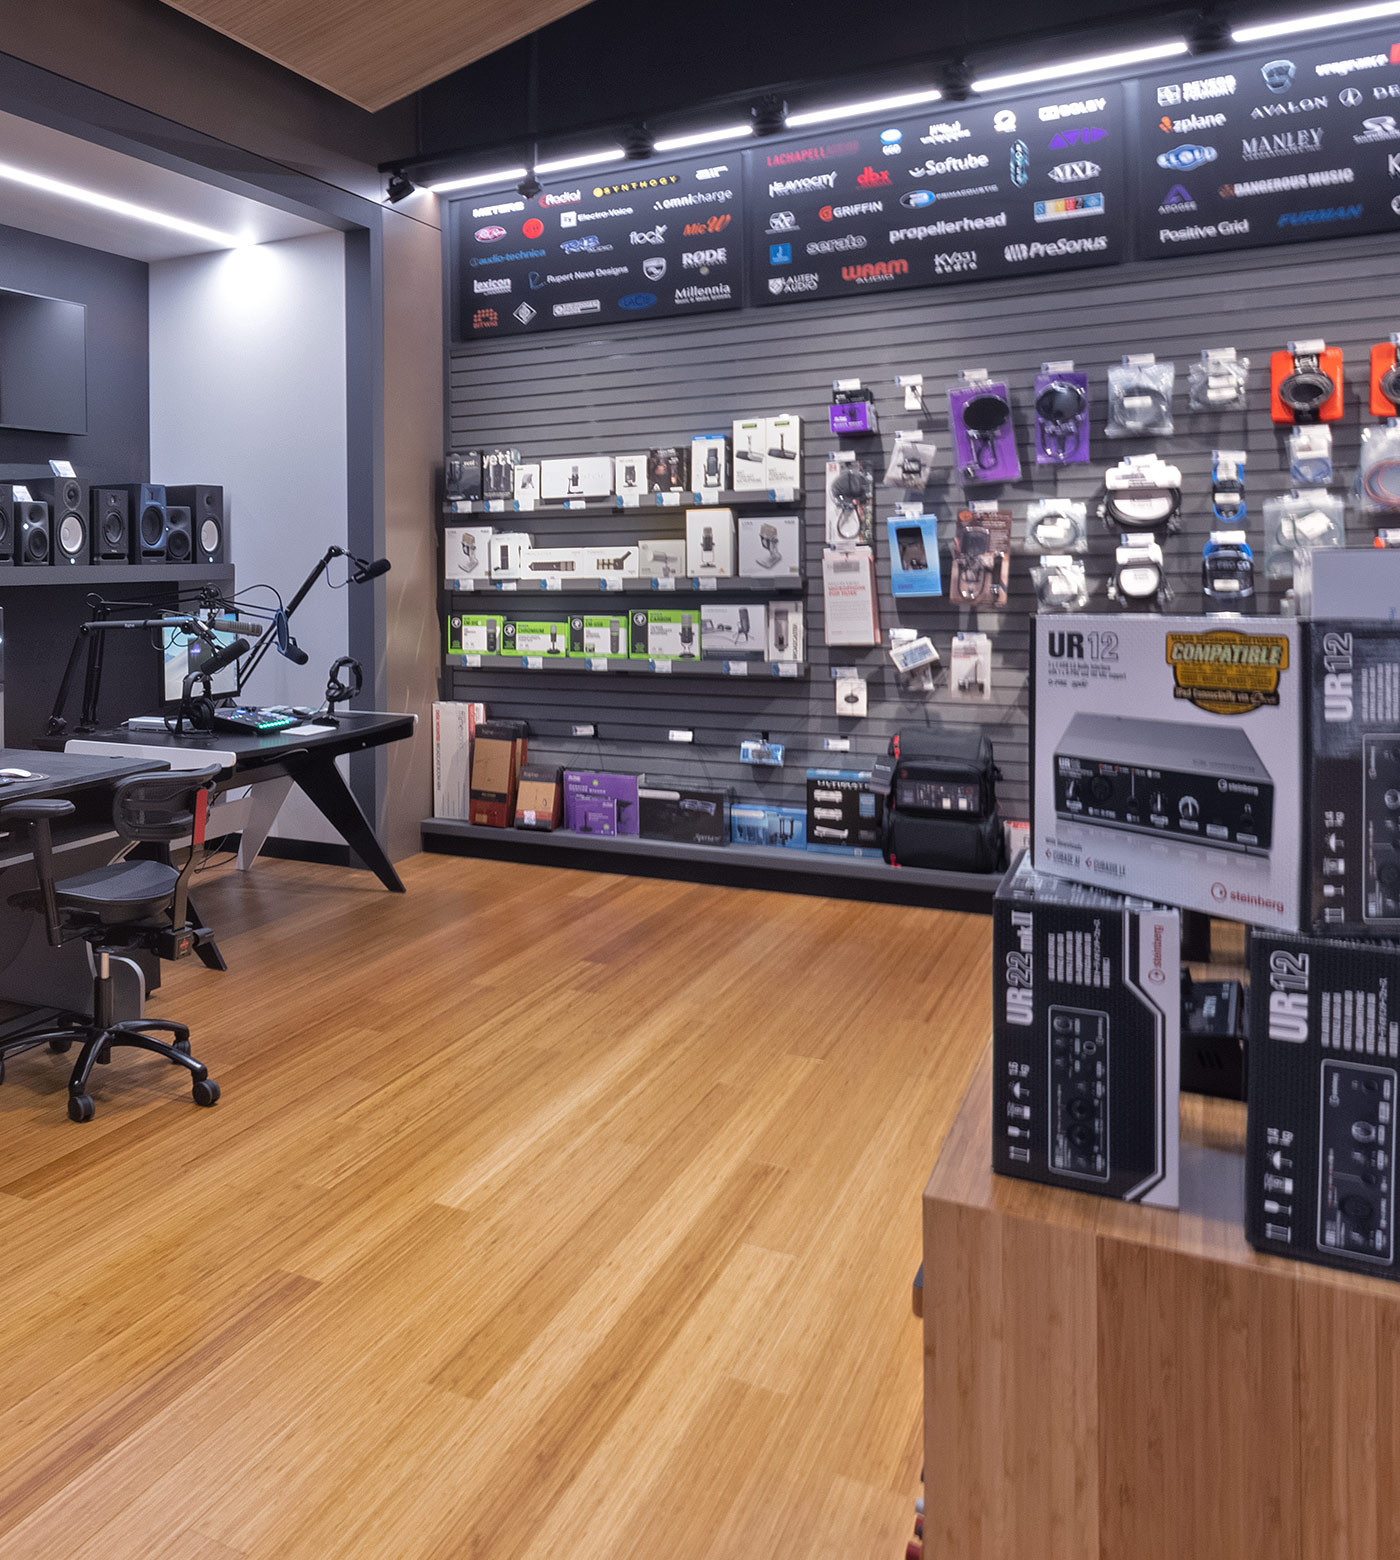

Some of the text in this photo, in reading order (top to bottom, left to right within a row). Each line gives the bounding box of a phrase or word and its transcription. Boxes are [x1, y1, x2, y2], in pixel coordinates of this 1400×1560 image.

[1250, 96, 1328, 119] AVALON
[1173, 113, 1227, 134] zplane
[1242, 127, 1324, 155] MANLEY
[924, 153, 989, 176] Softube
[1234, 167, 1355, 198] DANGEROUS MUSIC
[545, 189, 582, 206] Radial
[1158, 201, 1198, 215] APOGEE
[832, 201, 883, 219] GRIFFIN
[1278, 204, 1363, 226] FURMAN
[889, 211, 1007, 244] propellerhead
[1160, 218, 1250, 243] Positive Grid
[1029, 235, 1108, 259] PreSonus
[473, 278, 512, 293] lexicon
[675, 283, 731, 299] Millennia
[483, 450, 512, 469] yeti
[1171, 642, 1283, 666] COMPATIBLE
[1324, 632, 1353, 722] UR12
[1230, 892, 1285, 912] steinberg
[1153, 924, 1164, 968] steinberg
[1269, 950, 1310, 1044] UR12
